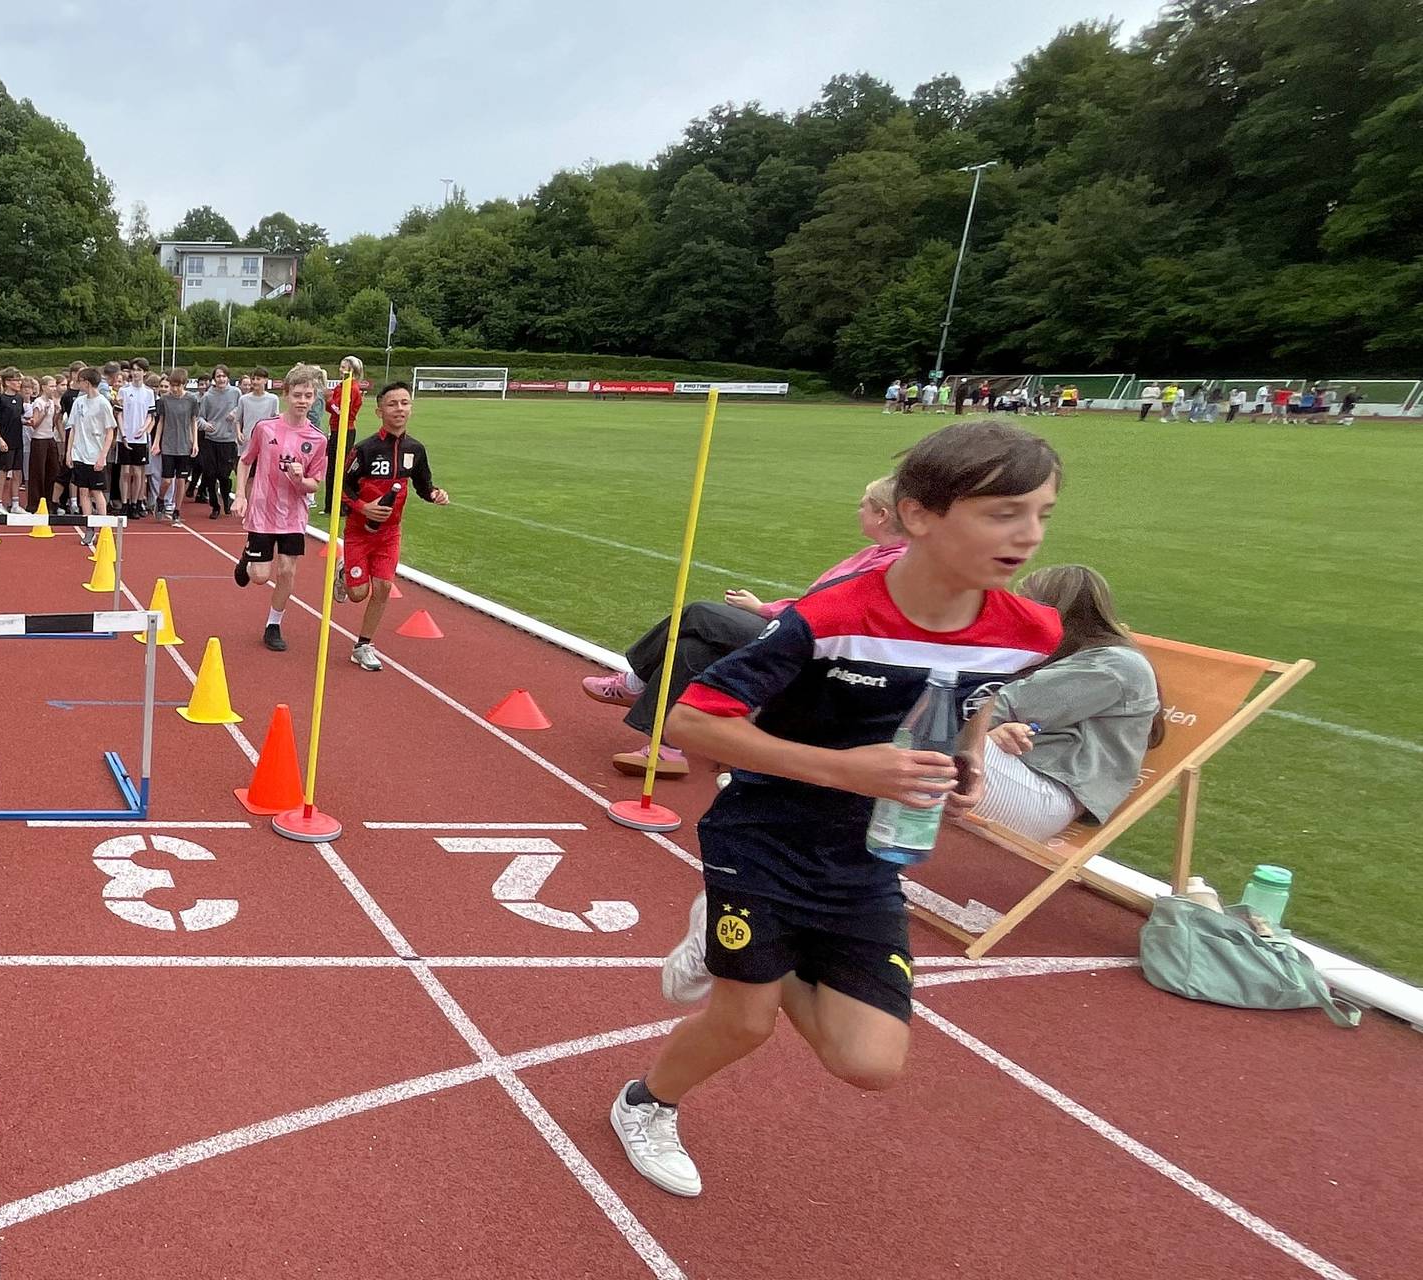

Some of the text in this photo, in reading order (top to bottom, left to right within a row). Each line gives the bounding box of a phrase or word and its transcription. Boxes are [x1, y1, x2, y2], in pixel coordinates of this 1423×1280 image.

[371, 461, 390, 475] 28
[92, 834, 238, 931] 3
[433, 837, 639, 932] 2
[720, 919, 745, 941] BVB
